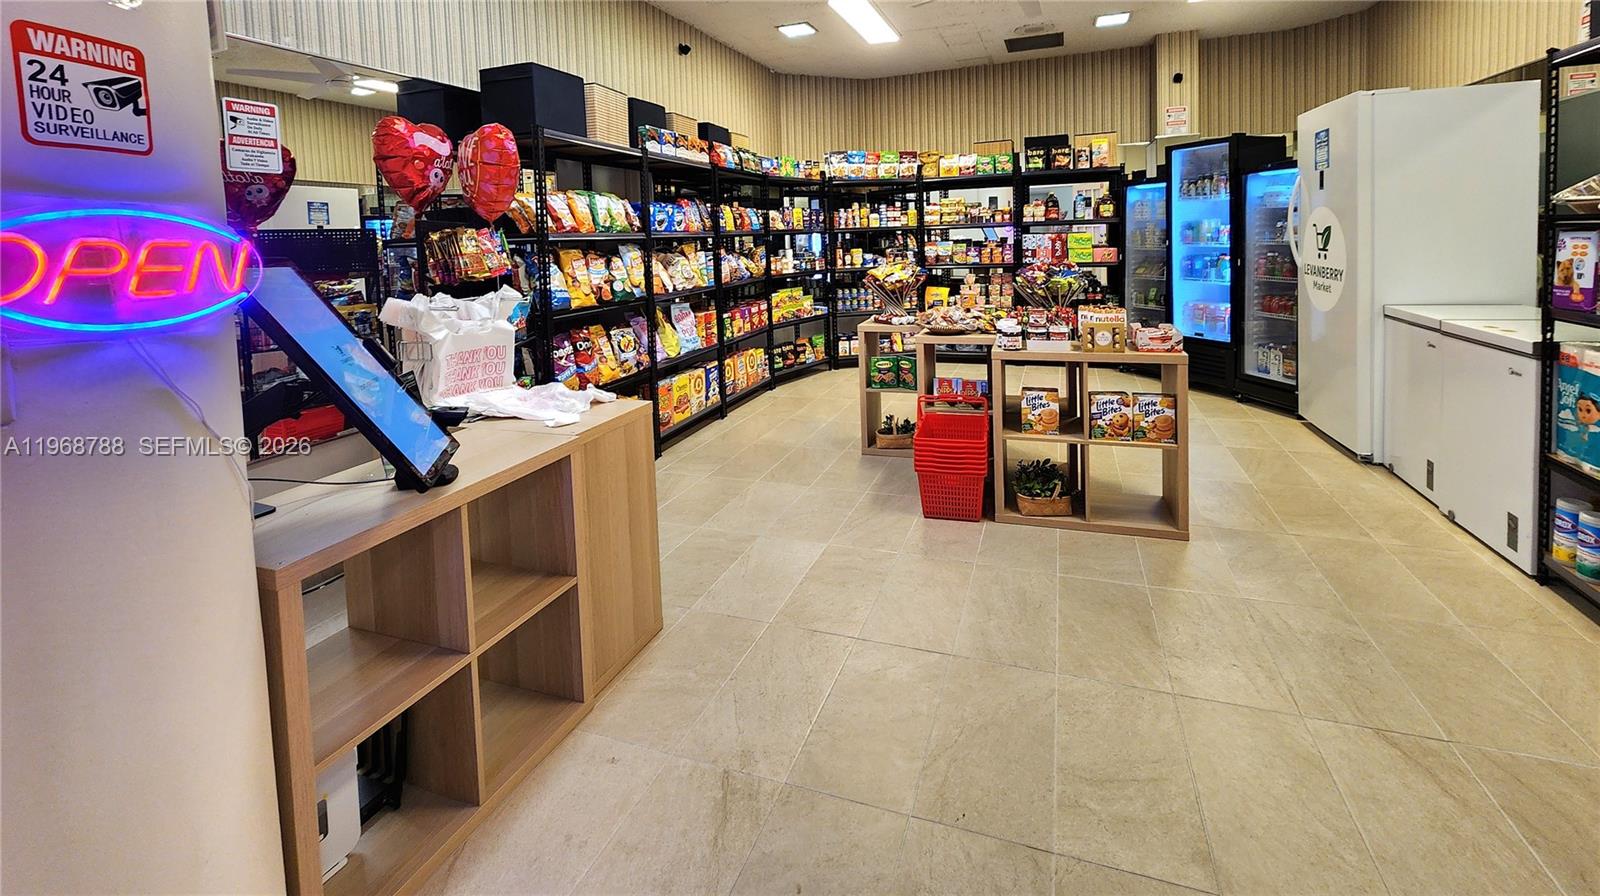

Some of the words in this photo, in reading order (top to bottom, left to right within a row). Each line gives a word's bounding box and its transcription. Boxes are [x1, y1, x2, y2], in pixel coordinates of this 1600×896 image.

[25, 27, 137, 72] WARNING
[26, 58, 69, 87] 24
[29, 84, 72, 104] HOUR
[32, 102, 95, 125] VIDEO
[230, 102, 271, 115] WARNING
[33, 120, 146, 145] SURVEILLANCE
[231, 135, 275, 147] ADVERTENCIA
[1303, 262, 1344, 282] LEVANBERRY
[1312, 280, 1332, 293] Market
[1095, 314, 1125, 322] nutella
[1025, 393, 1044, 406] Little
[1031, 401, 1051, 411] Bites
[1096, 398, 1116, 411] Little
[1138, 399, 1158, 413] Little
[1102, 406, 1122, 416] Bites
[1144, 407, 1166, 418] Bites
